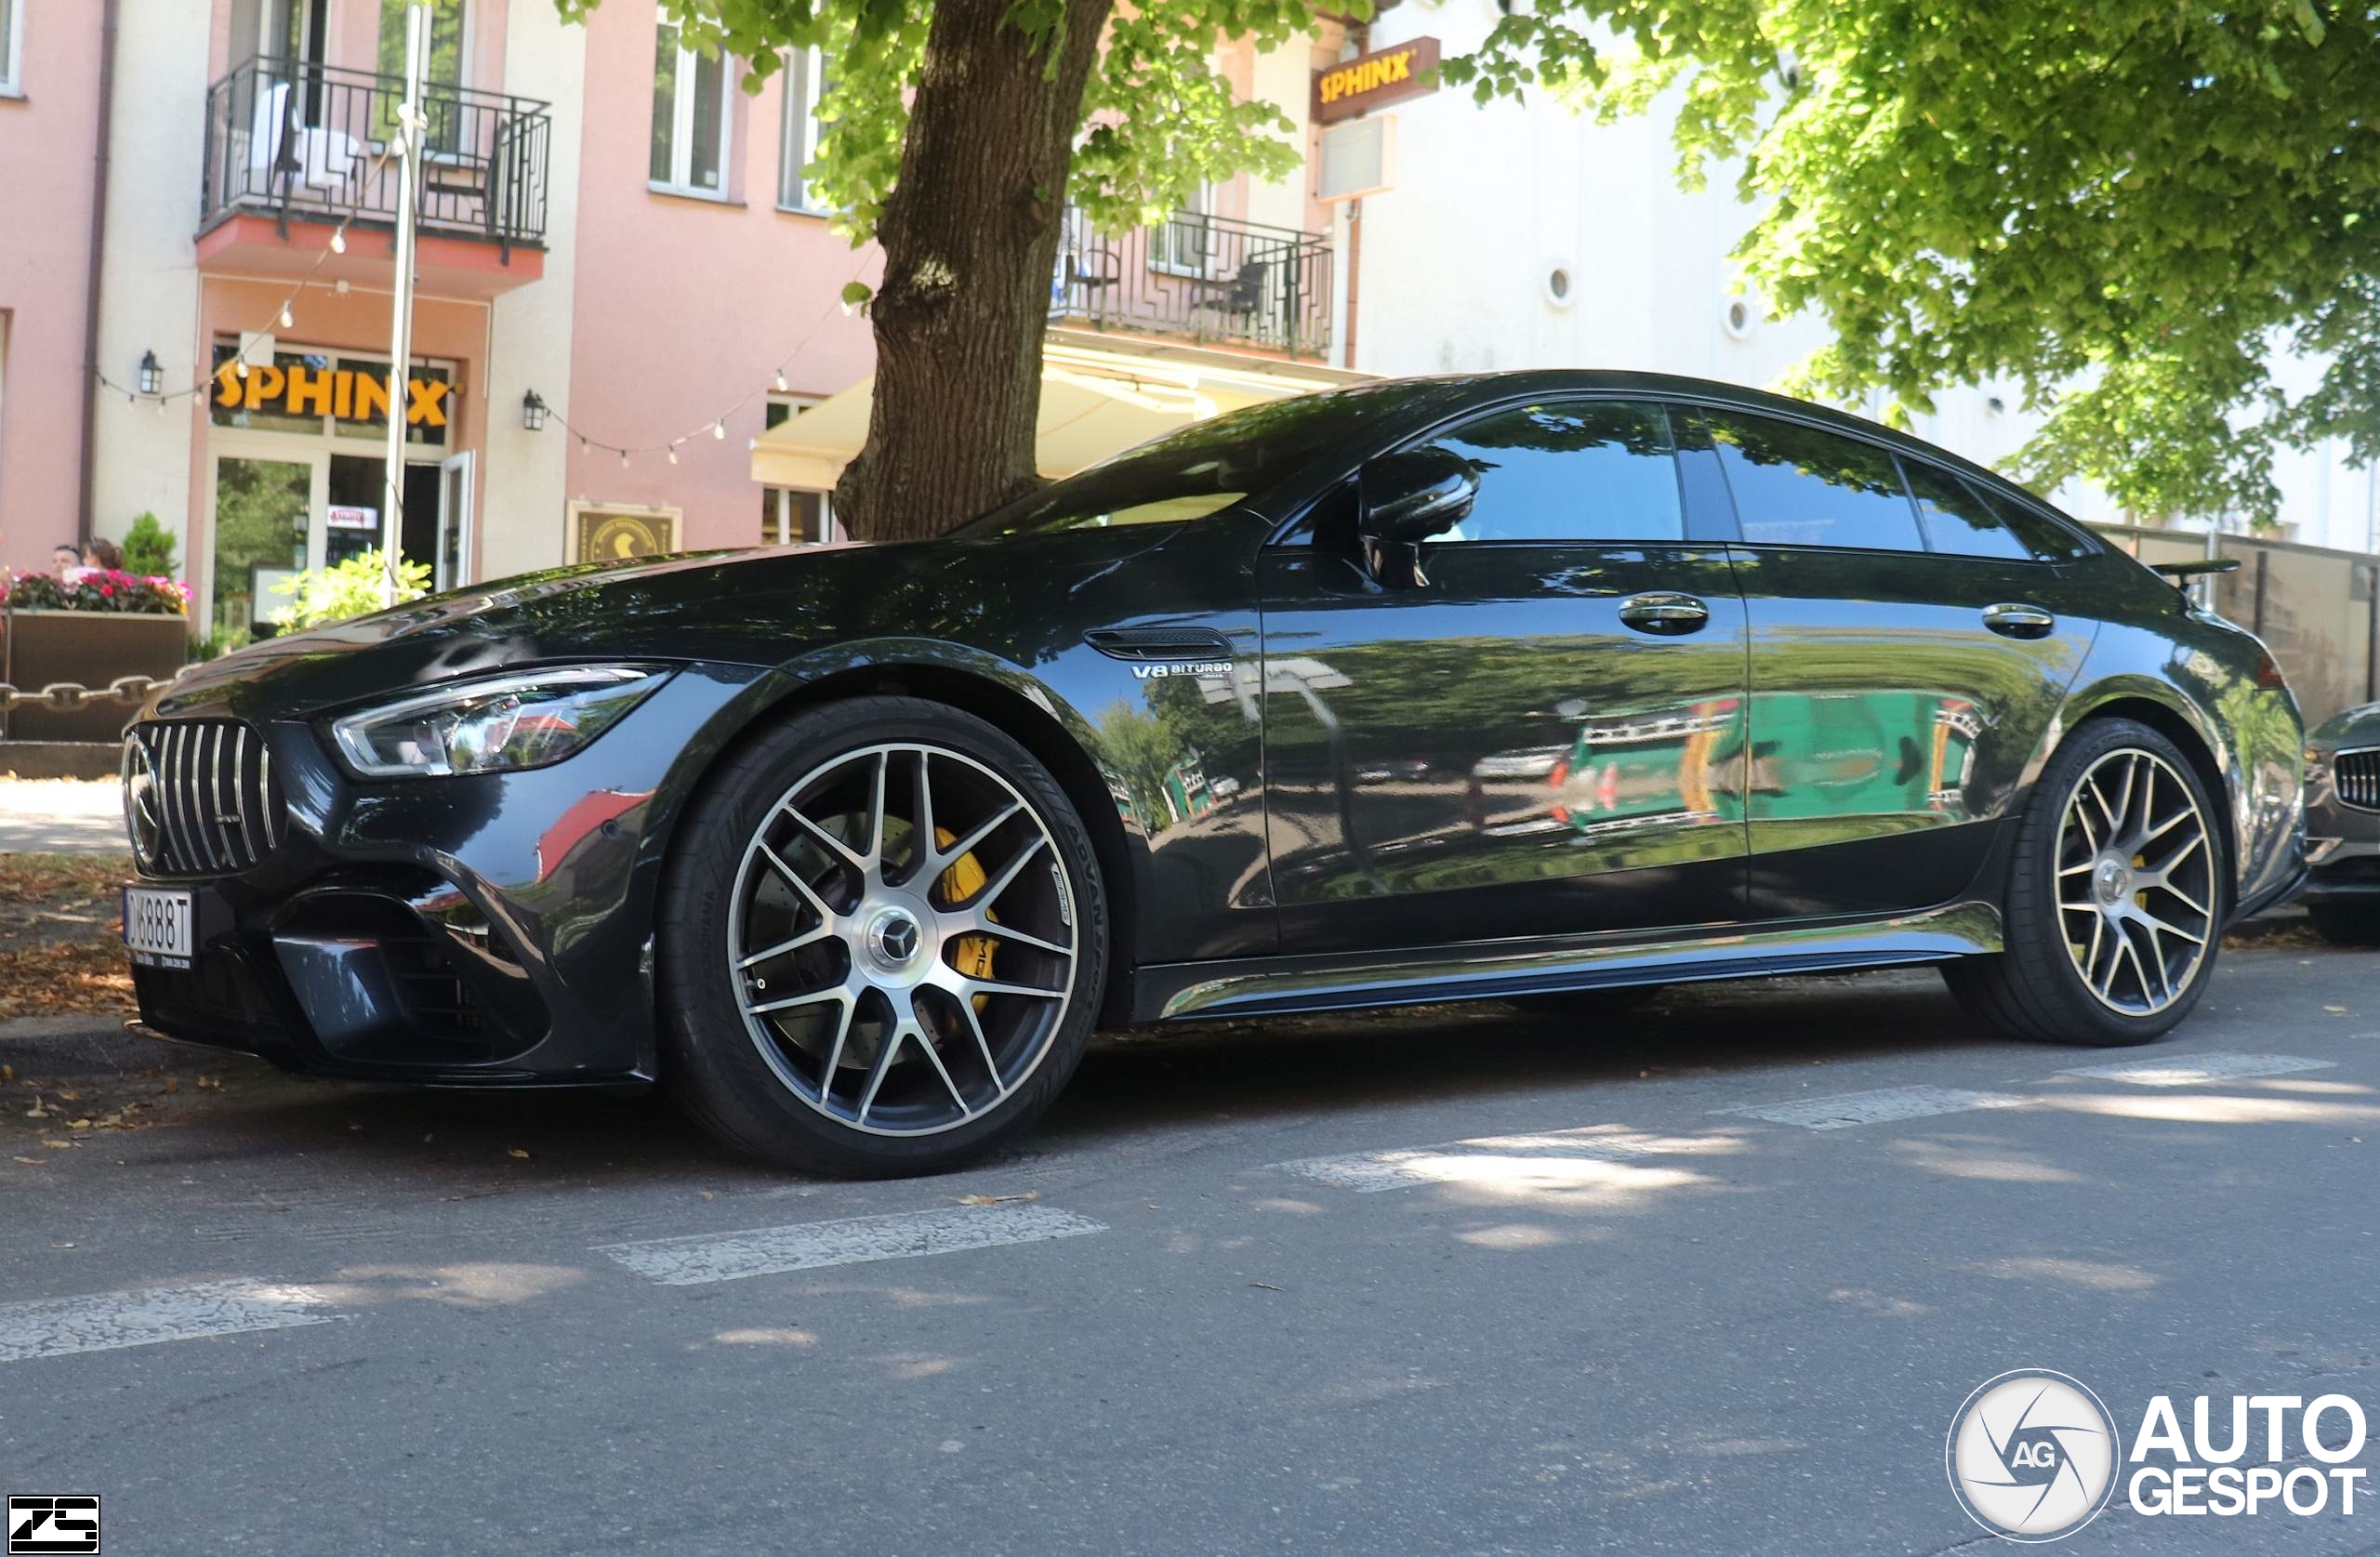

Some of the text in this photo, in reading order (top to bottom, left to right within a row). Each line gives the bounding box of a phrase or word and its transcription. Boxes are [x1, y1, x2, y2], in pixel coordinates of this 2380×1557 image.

[1320, 50, 1410, 104] SPHINX
[216, 359, 449, 428] SPHINX
[1130, 662, 1233, 679] V8 BITURBO
